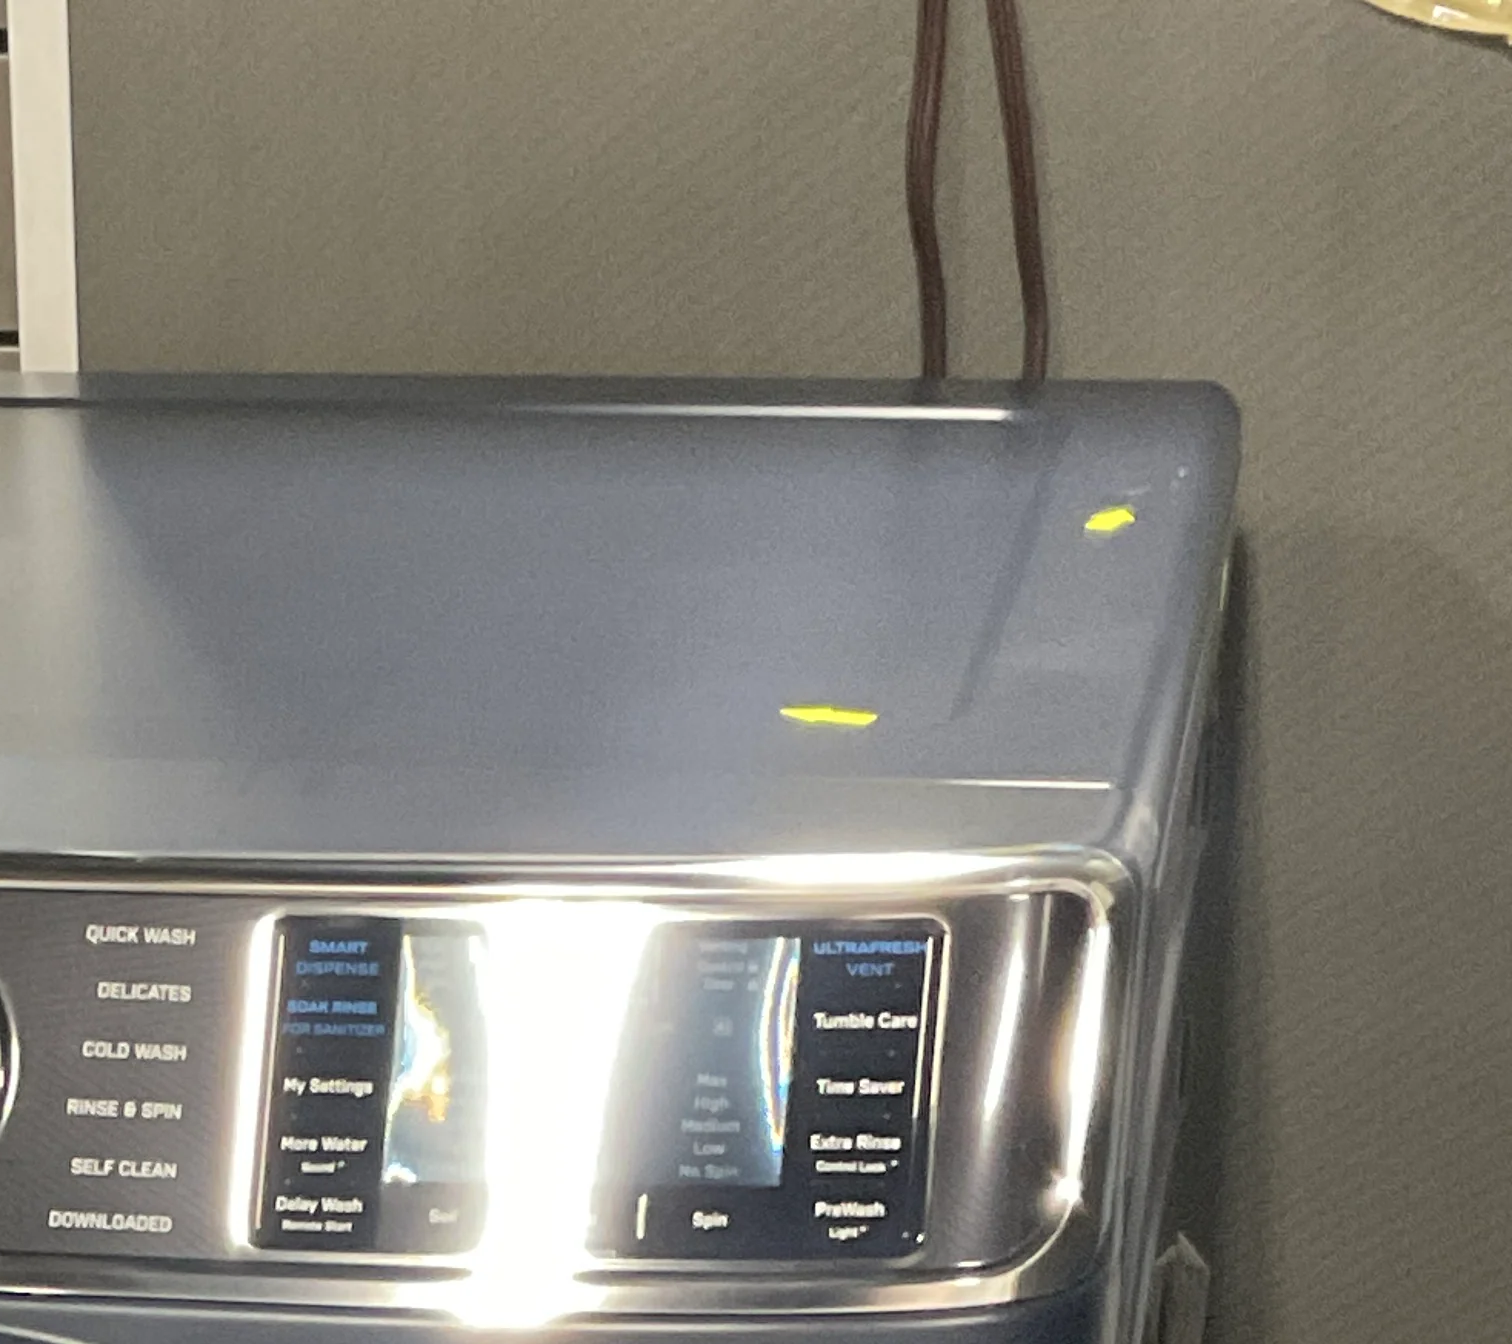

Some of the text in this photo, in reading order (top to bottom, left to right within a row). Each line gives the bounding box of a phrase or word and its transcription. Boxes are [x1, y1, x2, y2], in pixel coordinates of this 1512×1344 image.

[85, 924, 196, 946] QUICK WASH
[308, 939, 369, 954] SMART
[812, 939, 927, 956] ULTRAFRESH
[295, 960, 379, 976] DISPENSE
[845, 962, 895, 977] VENT
[97, 981, 192, 1003] DELICATES
[813, 1011, 918, 1030] Tumble Care
[82, 1040, 187, 1061] COLD WASH
[309, 1077, 374, 1098] Settings
[816, 1078, 906, 1095] Time Saver
[66, 1098, 119, 1118] RINSE
[141, 1101, 183, 1120] SPIN
[855, 1133, 902, 1151] Rinse
[70, 1157, 178, 1179] SELF CLEAN
[48, 1210, 173, 1233] DOWNLOADED
[692, 1211, 728, 1230] Spin
